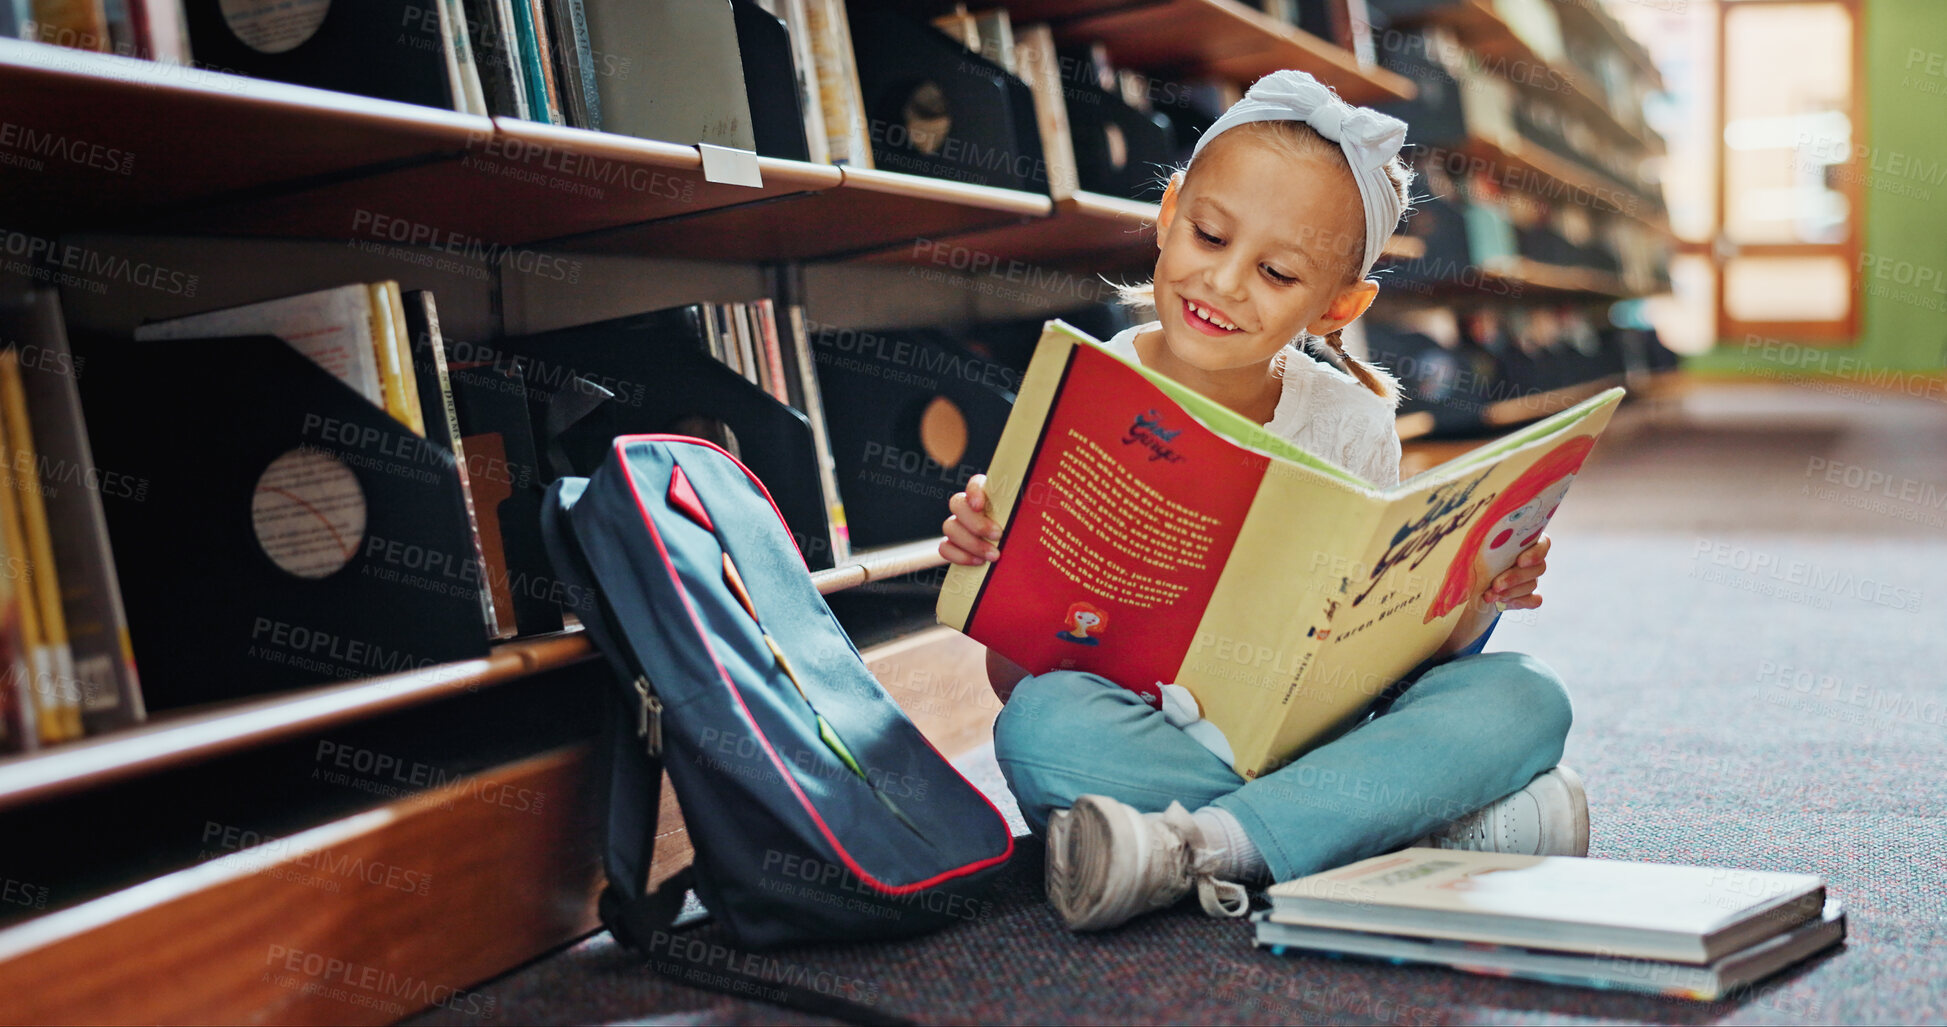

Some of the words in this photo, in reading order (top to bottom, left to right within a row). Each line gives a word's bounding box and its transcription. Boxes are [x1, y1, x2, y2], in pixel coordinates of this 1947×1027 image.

[1057, 472, 1072, 485] the
[1073, 483, 1097, 506] latest
[1130, 528, 1148, 540] and
[1150, 538, 1178, 552] other
[1180, 548, 1203, 560] best
[1060, 460, 1086, 482] friend
[1143, 524, 1177, 542] always
[1180, 539, 1193, 547] up
[1196, 544, 1208, 552] on
[1063, 451, 1100, 482] anything
[1101, 479, 1110, 489] to
[1111, 487, 1122, 499] be
[1164, 522, 1188, 535] With
[1190, 531, 1213, 543] best
[1076, 445, 1095, 463] teen
[1096, 462, 1113, 478] who
[1114, 477, 1140, 499] would
[1141, 497, 1153, 508] do
[1153, 505, 1174, 519] just
[1176, 517, 1206, 531] about
[1089, 441, 1117, 466] Ginger
[1117, 464, 1126, 474] is
[1134, 478, 1164, 502] middle
[1166, 500, 1199, 518] school
[1389, 462, 1500, 549] Just
[1041, 511, 1055, 525] Set
[1056, 523, 1065, 533] in
[1066, 531, 1082, 547] Salt
[1084, 545, 1104, 562] Lake
[1155, 580, 1188, 591] Ginger
[1041, 525, 1079, 557] struggles
[1080, 556, 1100, 572] with
[1102, 570, 1137, 587] typical
[1139, 585, 1180, 598] teenage
[1048, 477, 1074, 500] friend
[1103, 522, 1128, 541] could
[1129, 539, 1151, 552] care
[1153, 549, 1173, 561] less
[1176, 558, 1206, 570] about
[1060, 500, 1094, 532] climbing
[1096, 529, 1110, 542] the
[1112, 541, 1140, 559] social
[1352, 492, 1497, 607] Ginger
[1039, 536, 1065, 559] issues
[1066, 558, 1076, 567] as
[1078, 567, 1093, 579] she
[1095, 577, 1118, 591] tries
[1135, 593, 1162, 602] make
[1048, 556, 1081, 583] through
[1083, 582, 1115, 600] middle
[1334, 619, 1374, 644] Karen
[1378, 592, 1422, 621] Burnes
